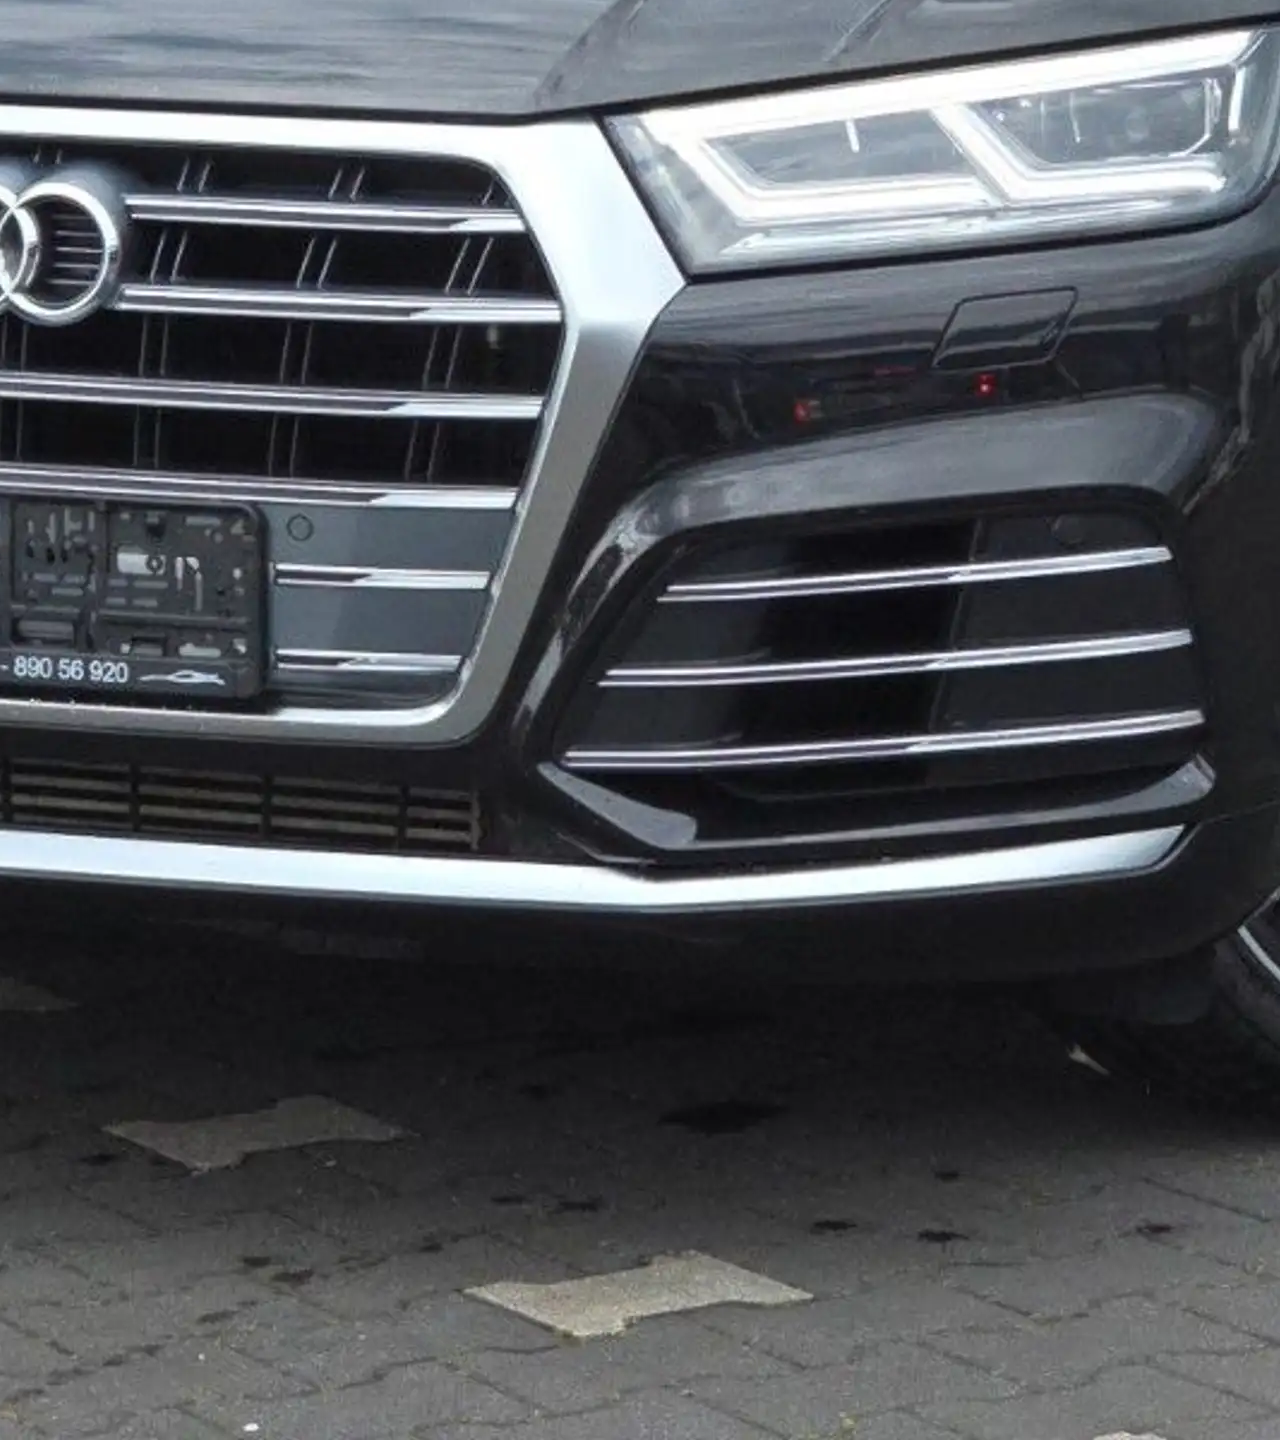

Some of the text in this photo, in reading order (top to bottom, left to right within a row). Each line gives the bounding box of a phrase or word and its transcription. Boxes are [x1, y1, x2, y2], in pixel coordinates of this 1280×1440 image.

[13, 655, 53, 679] 890
[58, 658, 85, 681] 56
[88, 660, 129, 683] 920
